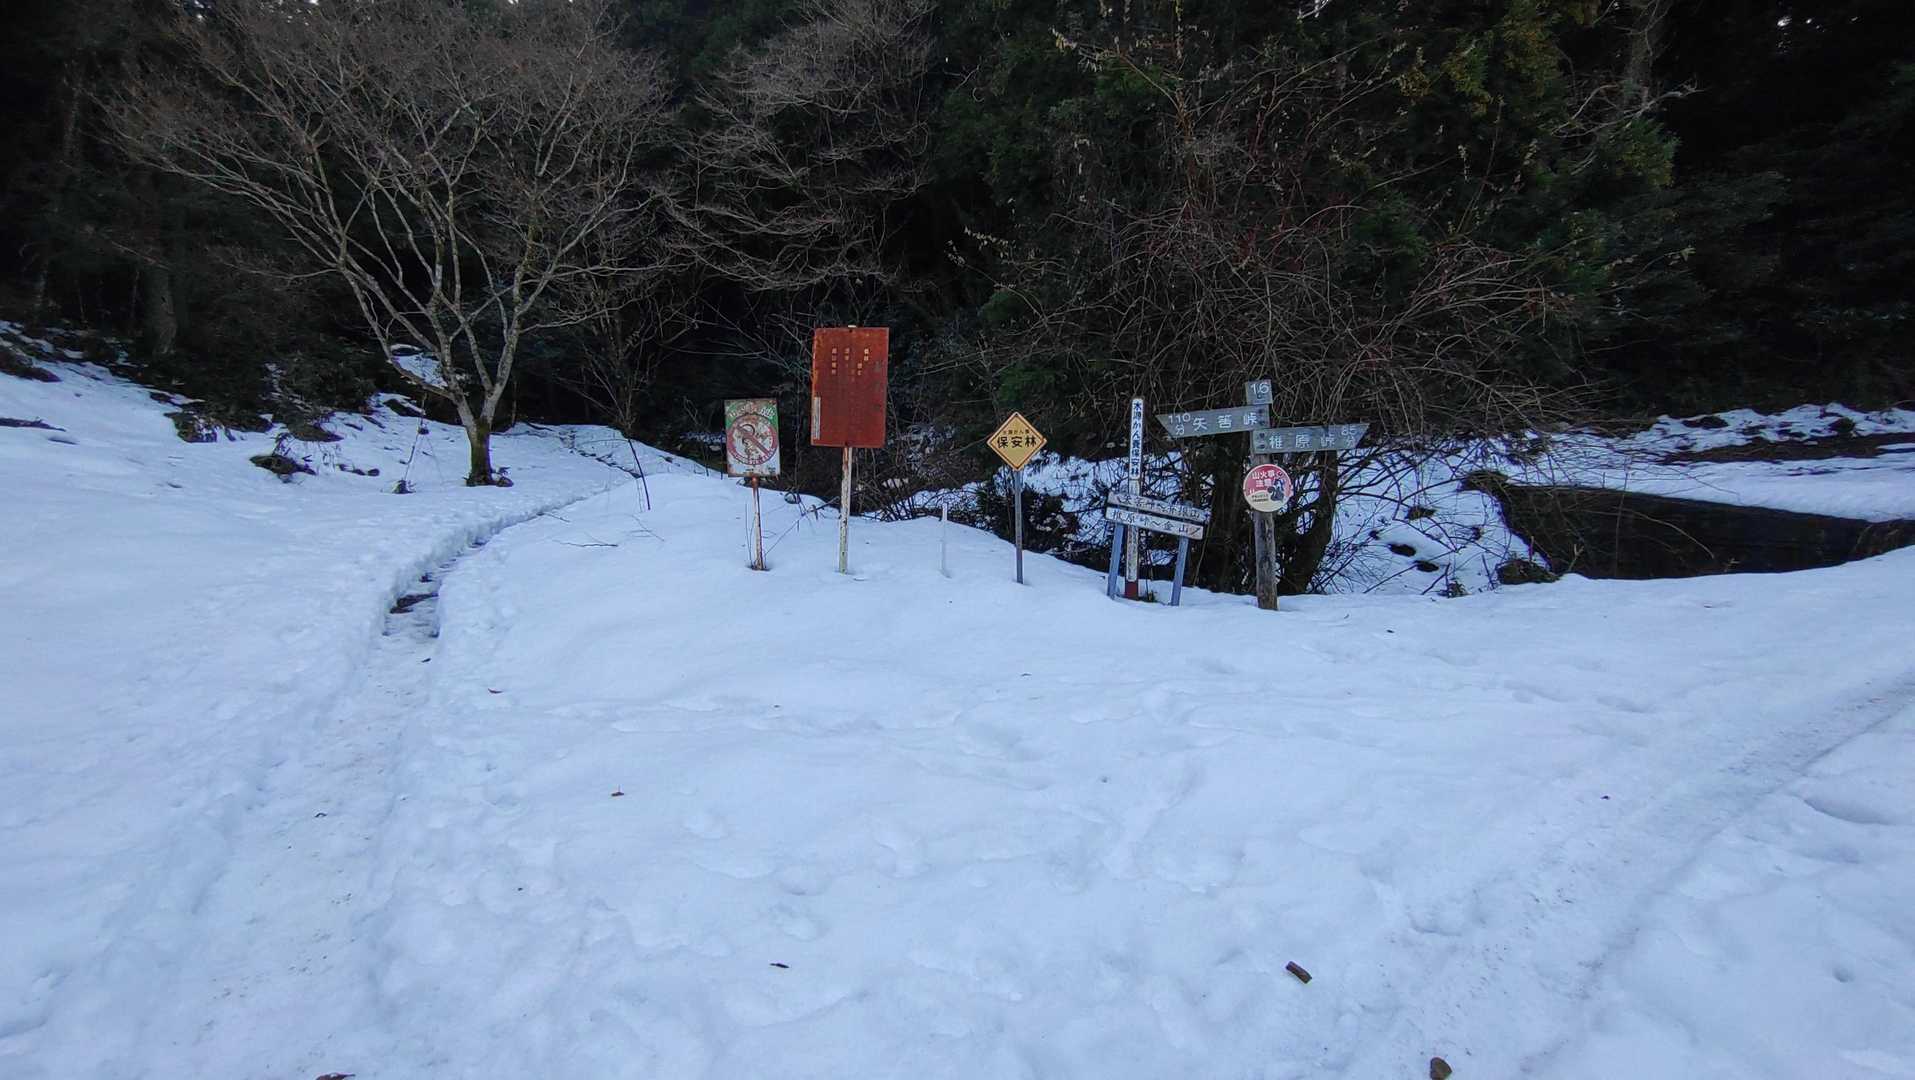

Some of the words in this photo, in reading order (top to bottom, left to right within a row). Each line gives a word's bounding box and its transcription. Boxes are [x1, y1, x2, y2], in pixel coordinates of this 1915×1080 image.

[1168, 413, 1190, 424] 110
[1192, 413, 1258, 431] 矢筈峠
[1175, 424, 1185, 435] 分
[997, 435, 1037, 449] 保安林
[1131, 401, 1142, 475] 水源かん養保安林
[1269, 432, 1336, 449] 椎原峠
[1252, 469, 1275, 479] 山火事
